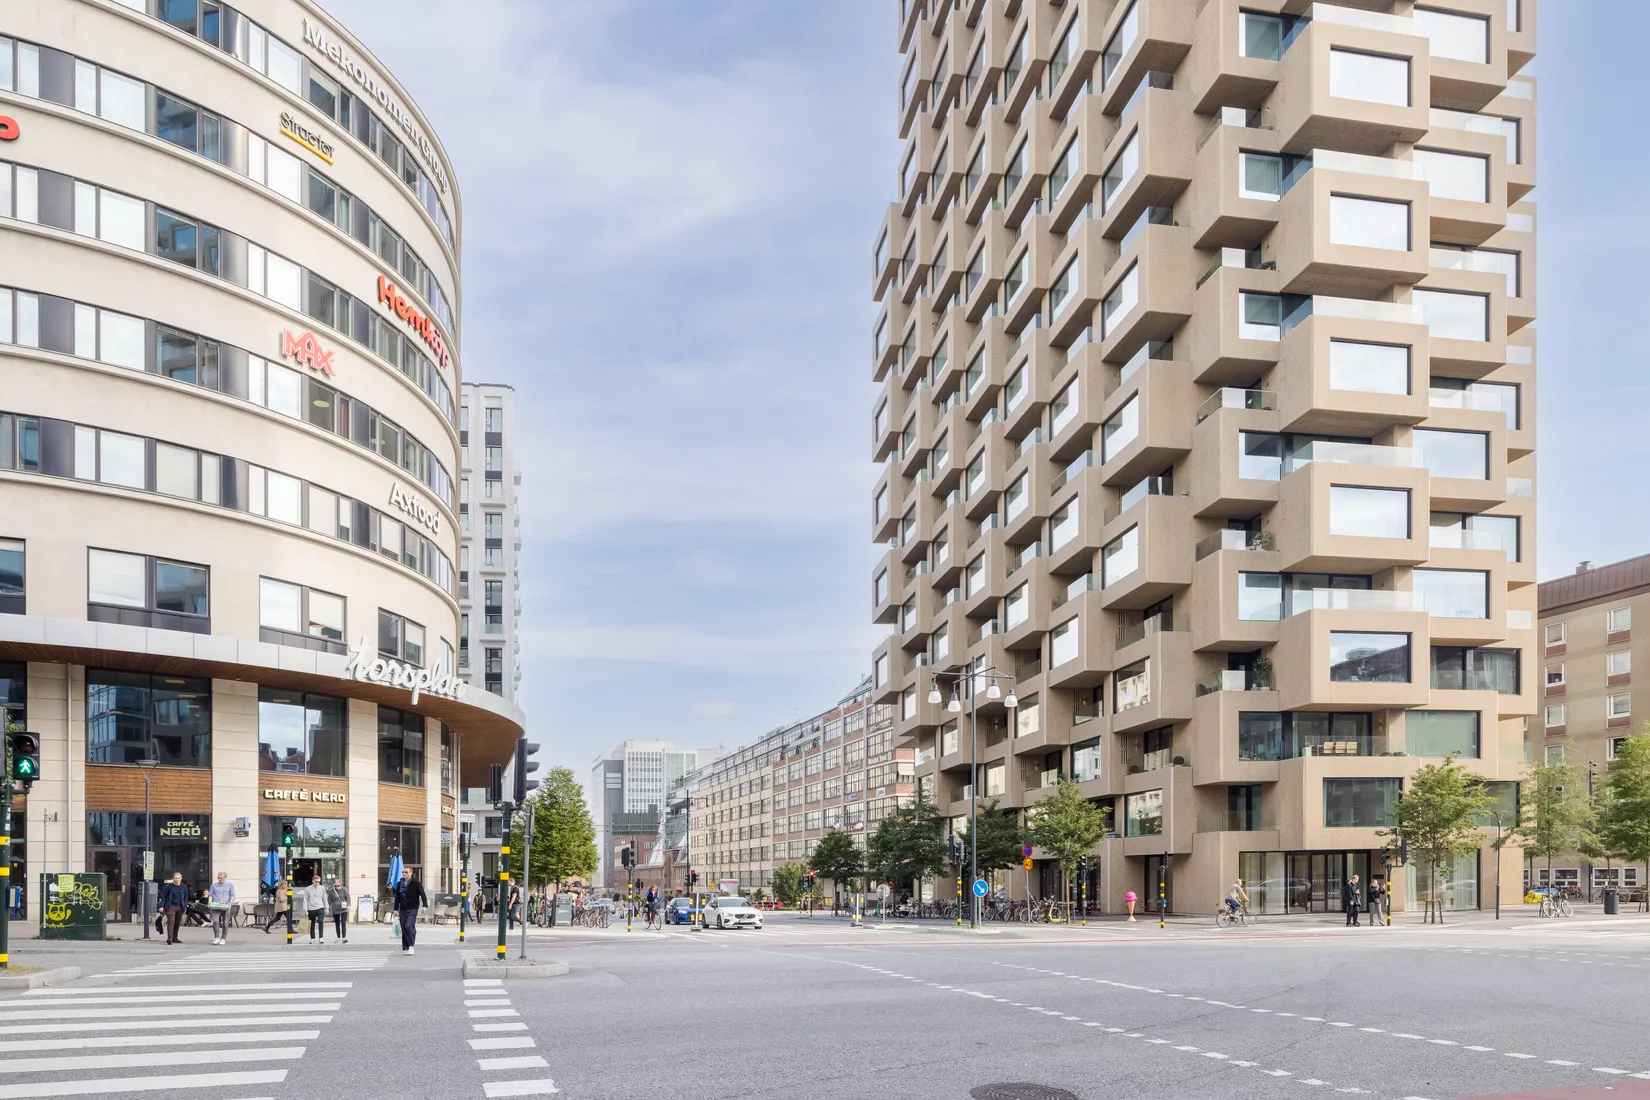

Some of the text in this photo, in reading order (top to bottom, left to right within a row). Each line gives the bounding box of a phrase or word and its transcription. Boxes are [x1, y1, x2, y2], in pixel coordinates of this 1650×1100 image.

[302, 17, 449, 194] Mekonomen Group
[280, 111, 335, 158] Structor
[377, 275, 449, 369] Hemköp
[282, 328, 336, 377] MAX
[389, 481, 440, 536] Axfood
[346, 636, 467, 706] torsplan
[264, 788, 346, 804] CAFFÈ NERO
[159, 827, 201, 836] NERO
